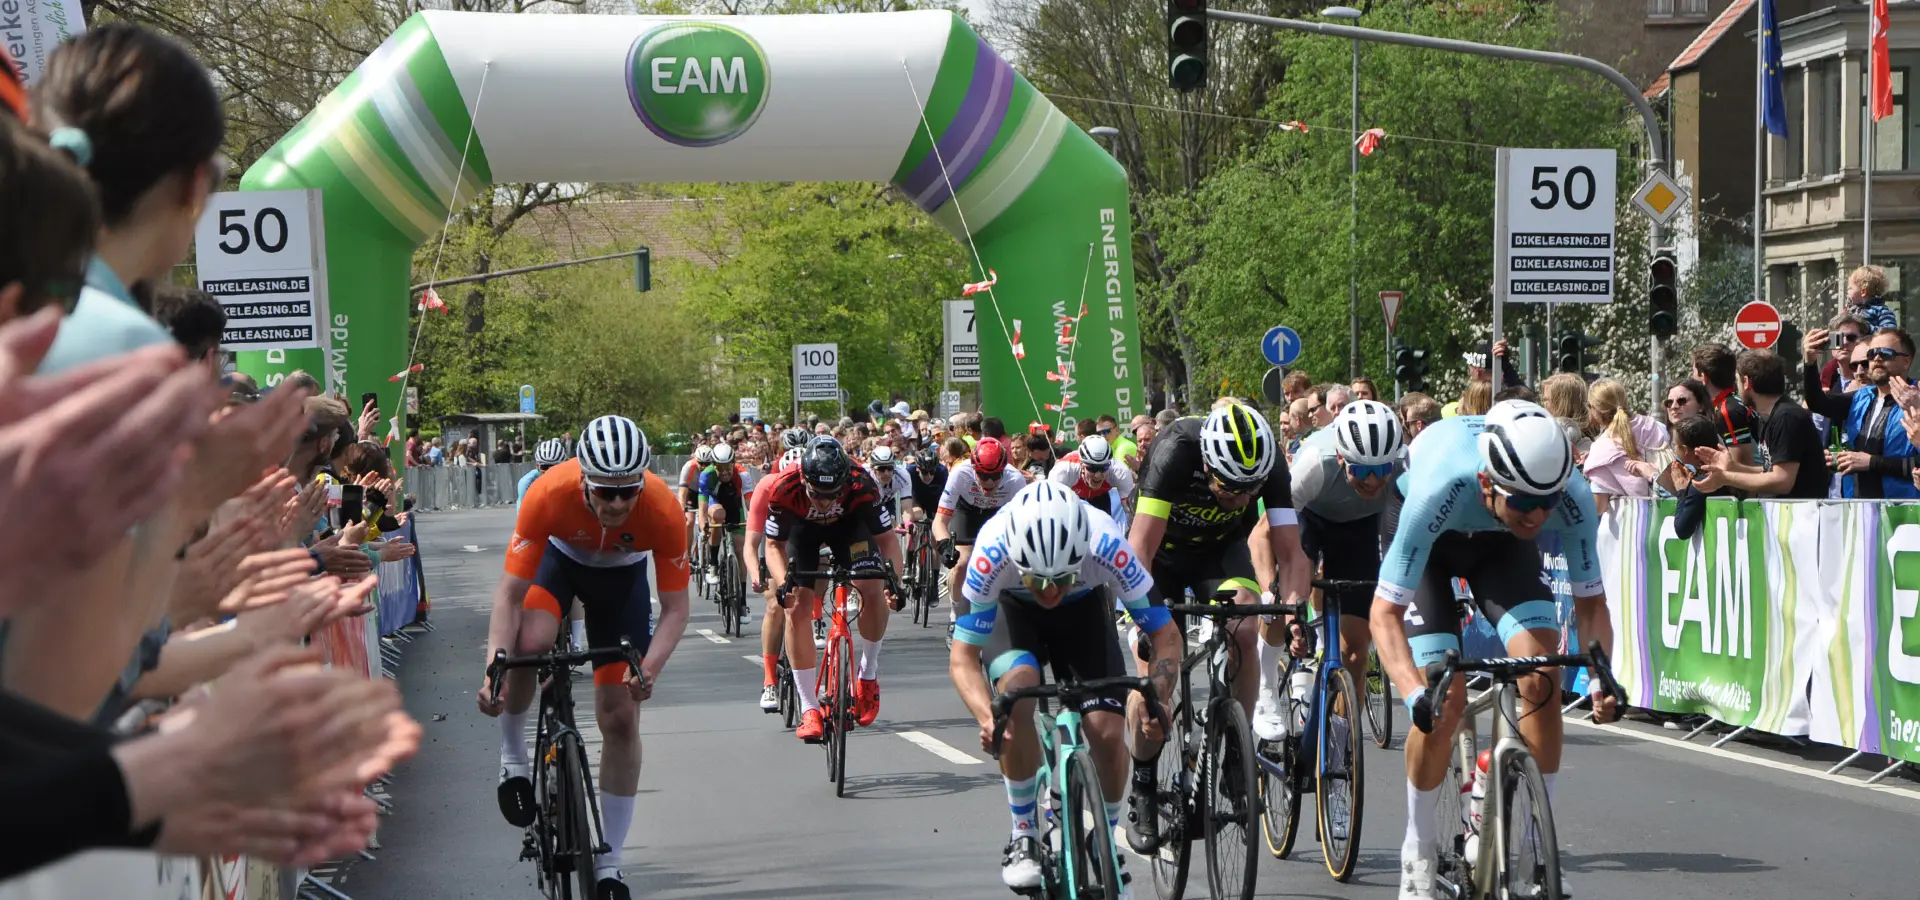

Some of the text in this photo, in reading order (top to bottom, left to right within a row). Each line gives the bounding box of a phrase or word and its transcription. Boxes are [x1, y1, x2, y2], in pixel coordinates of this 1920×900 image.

[651, 56, 748, 94] EAM
[1530, 165, 1597, 210] 50
[218, 207, 289, 255] 50
[1514, 235, 1608, 246] BIKELEASING.DE
[1100, 207, 1124, 321] ENERGIE
[1514, 258, 1607, 269] BIKELEASING.DE
[206, 280, 306, 293] BIKELEASING.DE
[1513, 282, 1607, 292] BIKELEASING.DE
[223, 304, 308, 317] KELEASING.DE
[963, 310, 976, 332] 7
[221, 328, 309, 341] KELEASING.DE
[331, 314, 348, 398] EAM.de
[1110, 327, 1129, 380] AUS
[801, 350, 835, 367] 100
[1052, 300, 1080, 442] wwwEAM.de
[1428, 477, 1467, 534] GARMIN
[967, 532, 1009, 593] Mobi
[1095, 532, 1146, 590] Mobil
[1658, 515, 1752, 660] EAM
[1659, 670, 1682, 705] Energie
[1699, 676, 1721, 703] der
[1718, 680, 1752, 712] Mitte
[1890, 709, 1920, 752] Ener
